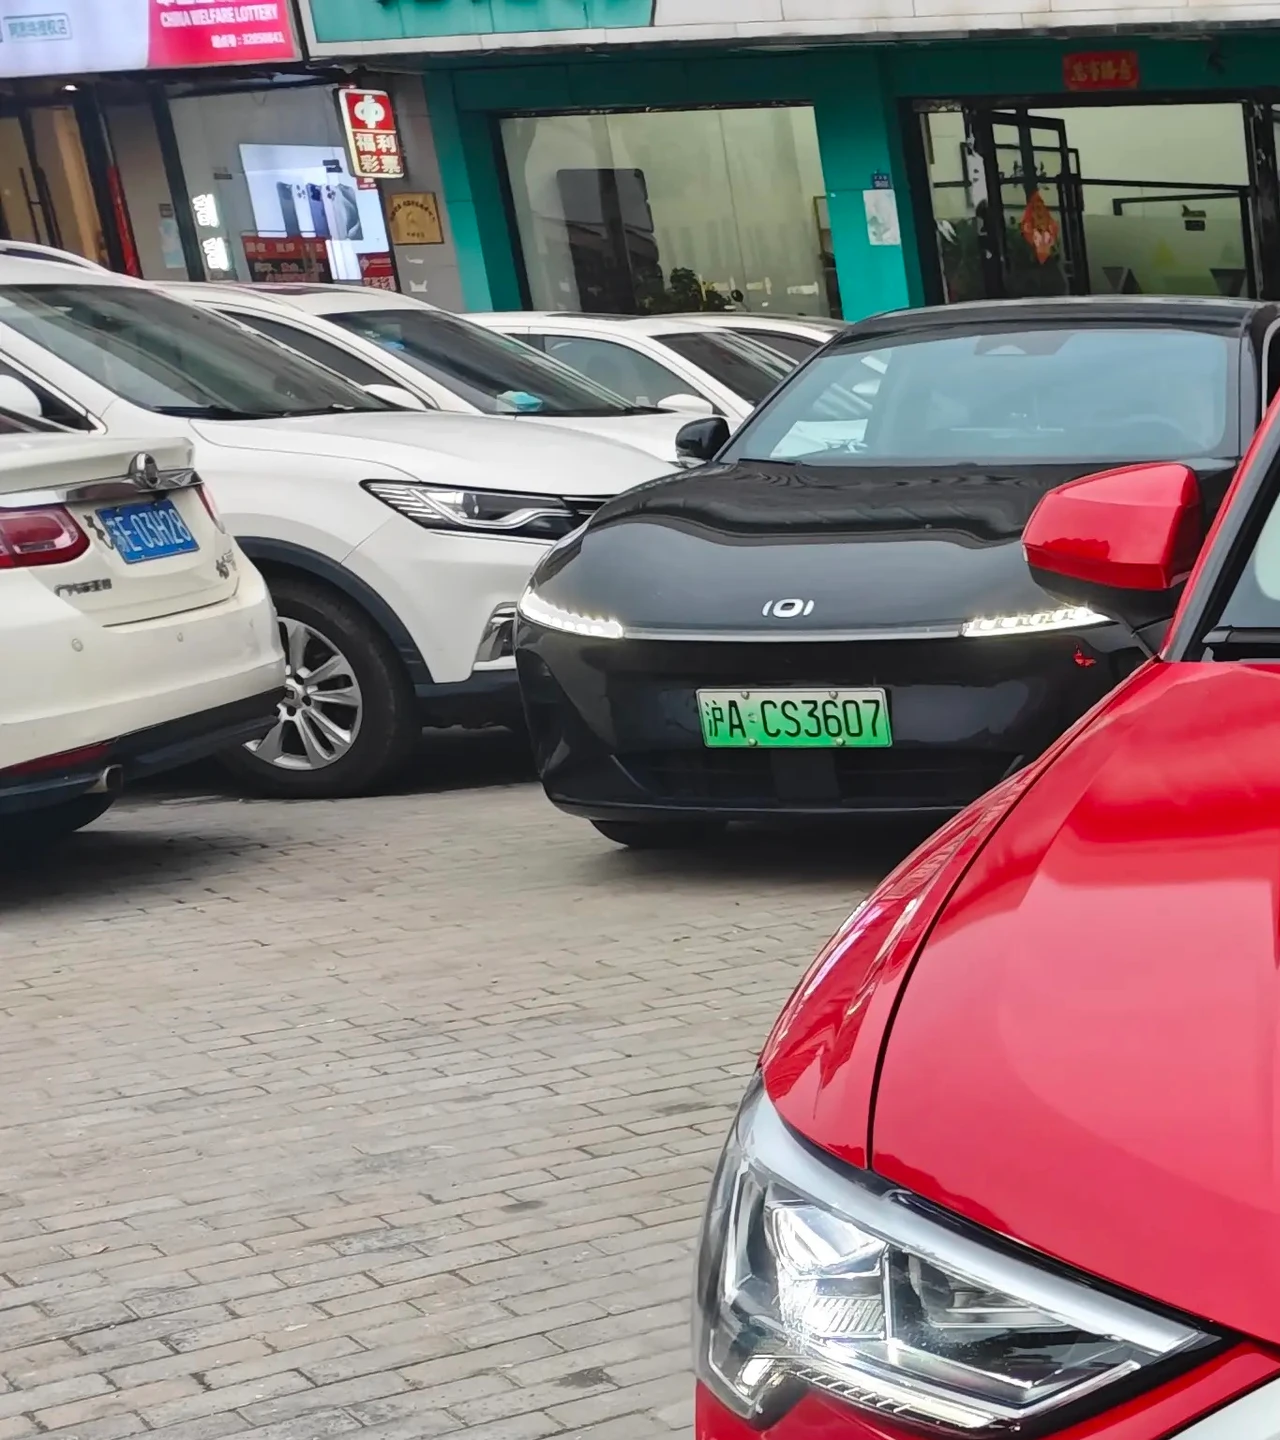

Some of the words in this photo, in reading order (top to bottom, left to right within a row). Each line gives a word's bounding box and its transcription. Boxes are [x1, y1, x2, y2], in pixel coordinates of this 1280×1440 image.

[191, 7, 235, 25] WELFARE
[235, 4, 278, 22] LOTTERY
[355, 132, 397, 152] 福利
[360, 154, 401, 174] 彩票
